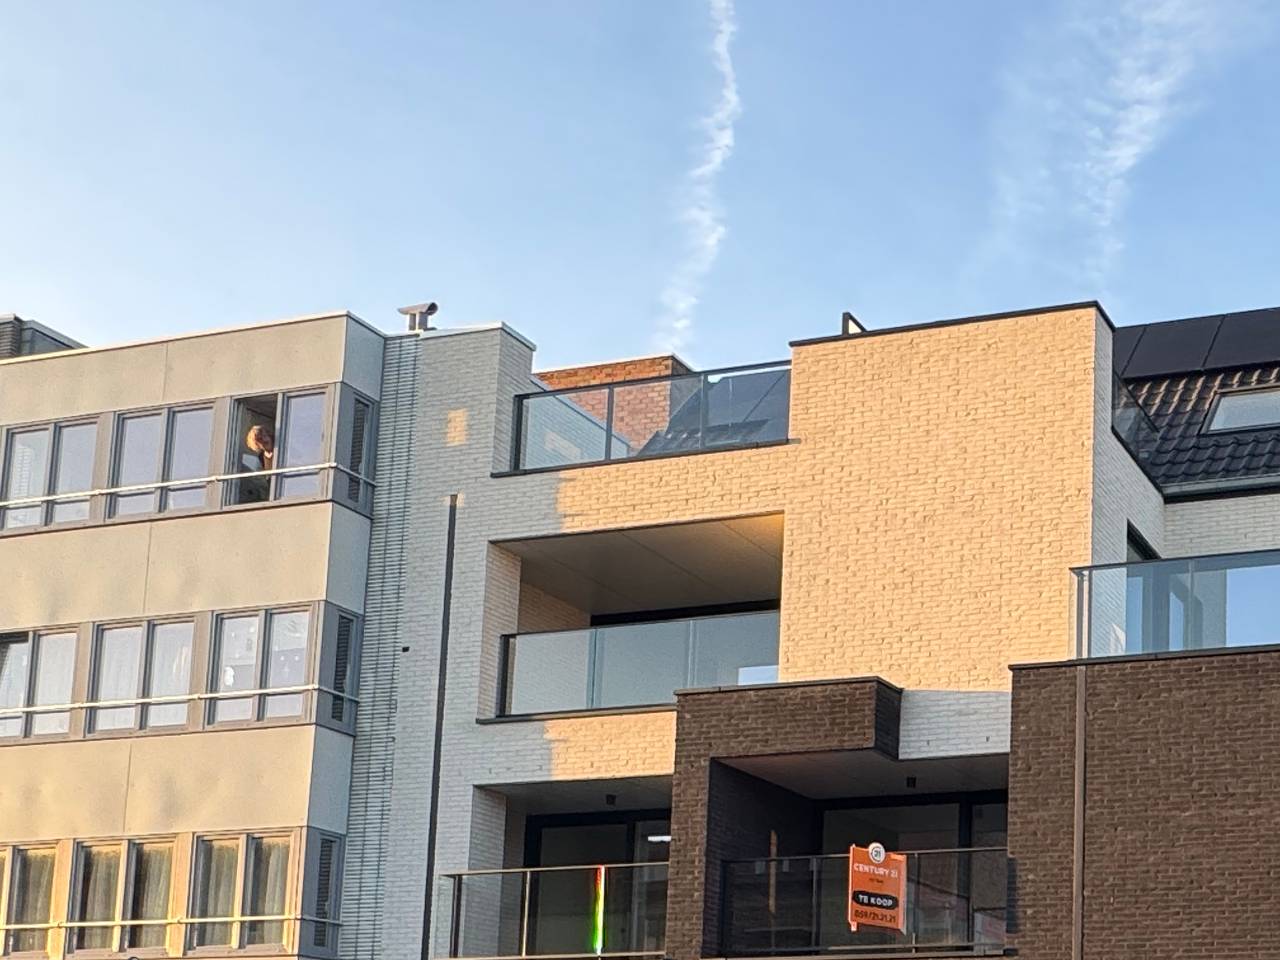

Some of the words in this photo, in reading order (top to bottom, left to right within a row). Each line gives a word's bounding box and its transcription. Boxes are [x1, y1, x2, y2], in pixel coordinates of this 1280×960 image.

[853, 863, 889, 876] CENTURY
[890, 869, 898, 878] 21
[858, 894, 869, 904] TE
[870, 896, 893, 907] KOOP
